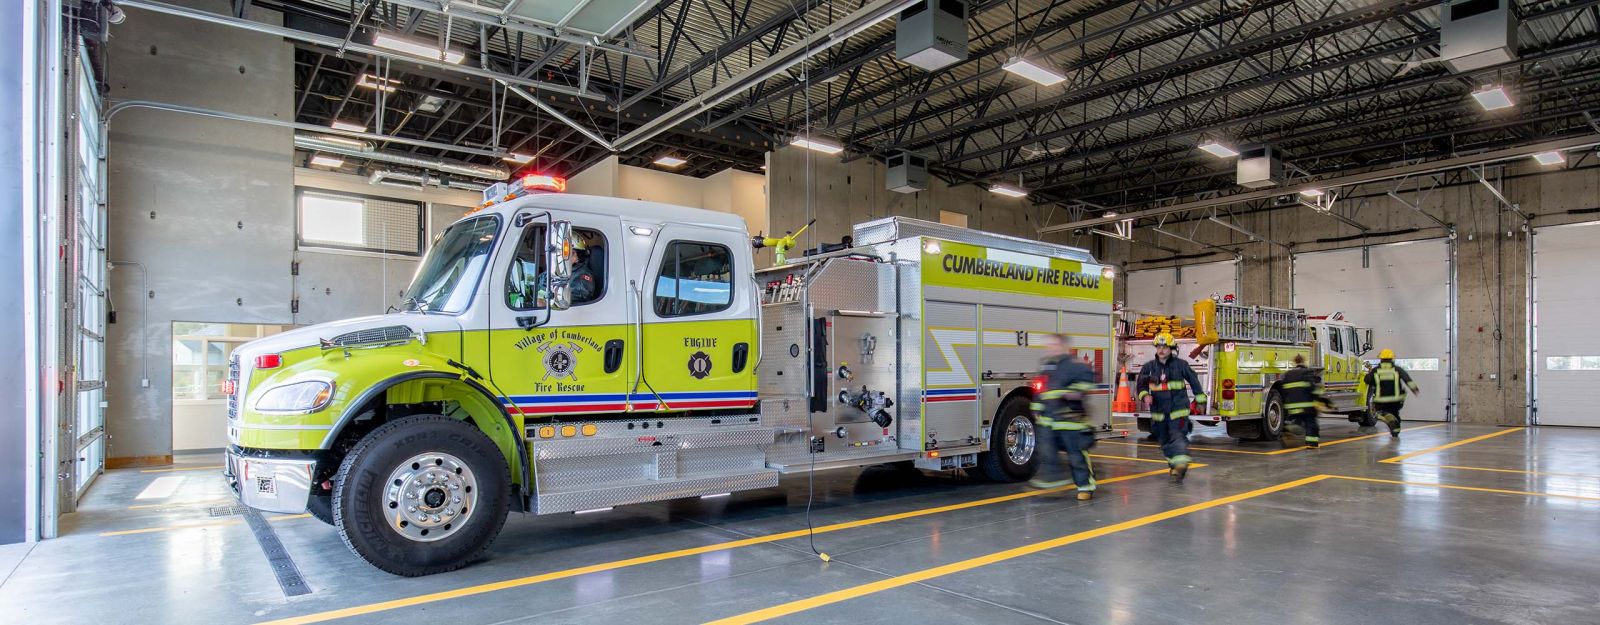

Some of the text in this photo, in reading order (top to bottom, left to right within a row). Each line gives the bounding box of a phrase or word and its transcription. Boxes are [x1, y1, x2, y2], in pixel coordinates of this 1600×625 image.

[942, 254, 1100, 289] CUMBERLAND FIRE RESCUE
[515, 329, 603, 352] Village of Cumberland
[684, 337, 717, 348] ENGINE
[534, 382, 585, 392] Fire Rescue
